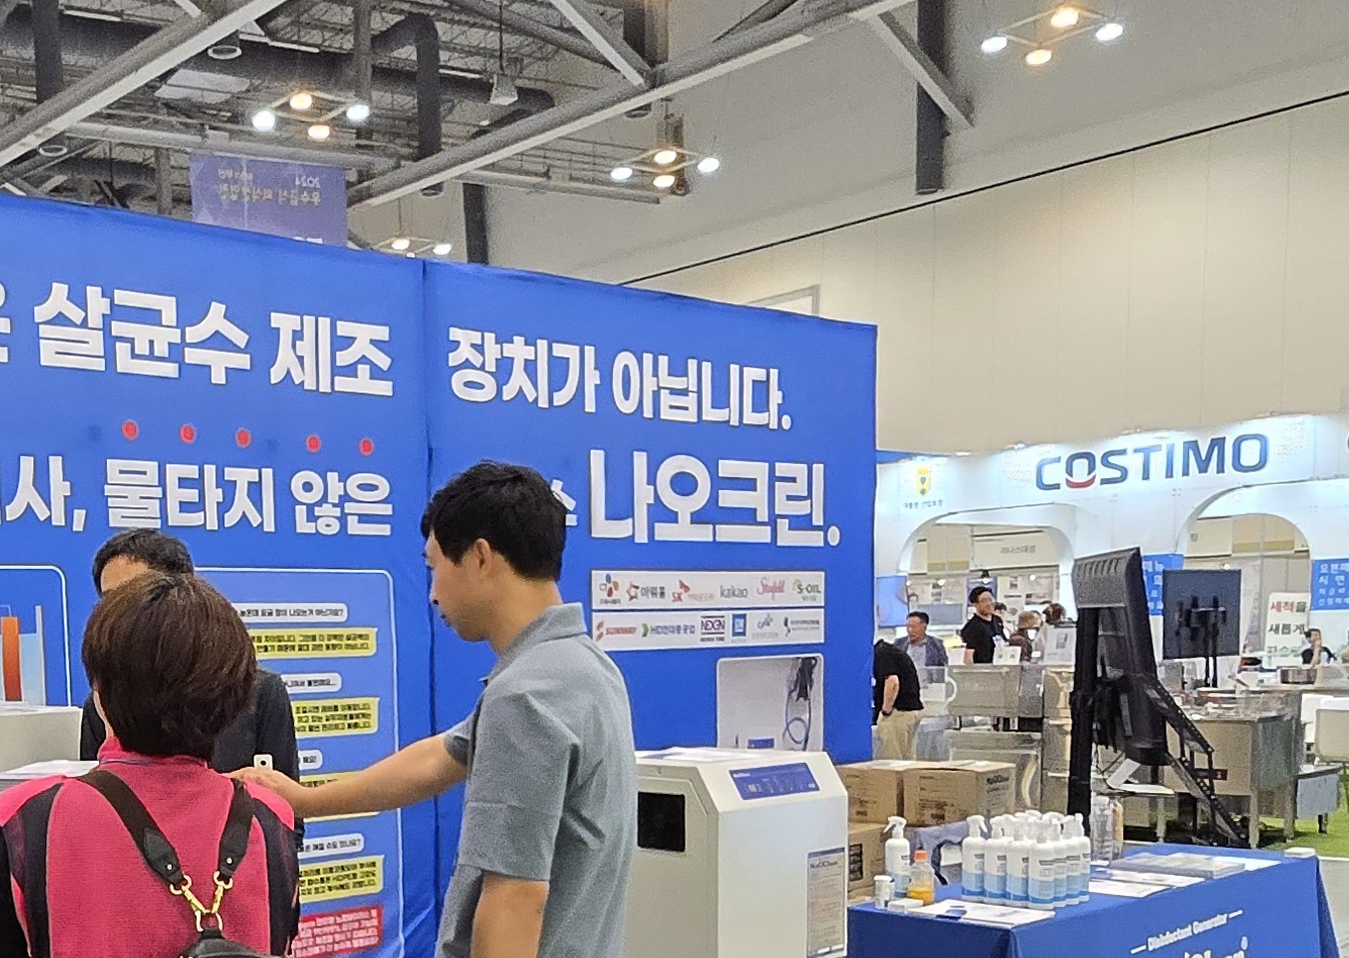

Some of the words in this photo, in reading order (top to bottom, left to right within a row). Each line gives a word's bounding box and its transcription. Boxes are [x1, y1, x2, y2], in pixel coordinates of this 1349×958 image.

[33, 282, 251, 385] 살균수
[268, 311, 394, 398] 제조
[448, 327, 600, 413] 장치가
[612, 351, 792, 430] 아닙니다.
[1035, 433, 1269, 490] COSTIMO
[104, 458, 275, 532] 물타지
[291, 469, 392, 537] 않은
[589, 449, 841, 548] 나오크린.
[720, 584, 748, 599] kakao
[797, 582, 822, 595] S-OIL
